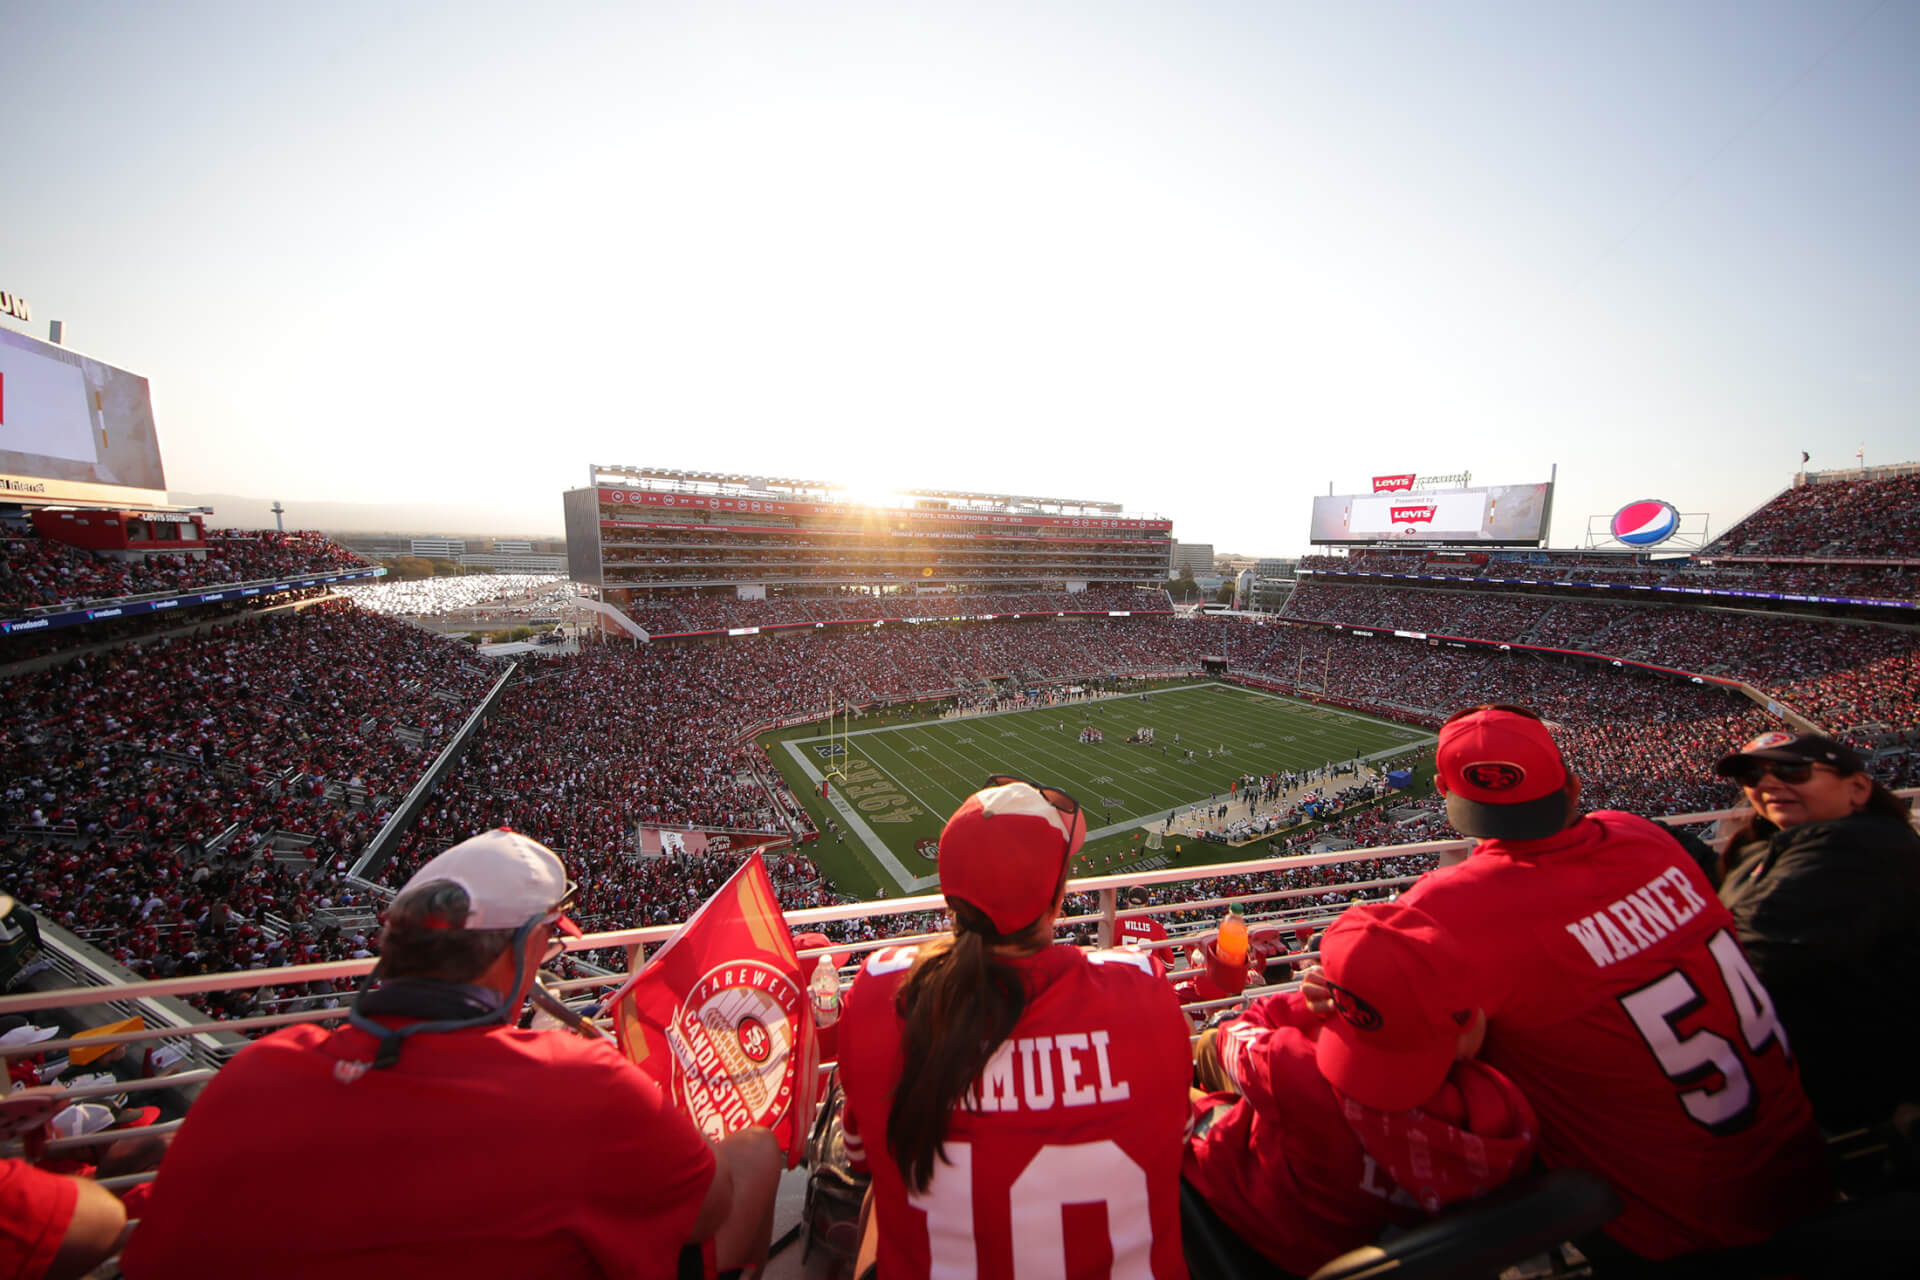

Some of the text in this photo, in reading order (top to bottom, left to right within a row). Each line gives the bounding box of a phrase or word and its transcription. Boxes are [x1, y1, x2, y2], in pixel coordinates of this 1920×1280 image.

[1124, 920, 1151, 933] WILLIS
[1566, 866, 1707, 968] WARNER
[701, 967, 796, 1012] FAREWELL
[1616, 927, 1793, 1134] 54
[955, 1030, 1131, 1112] MUEL
